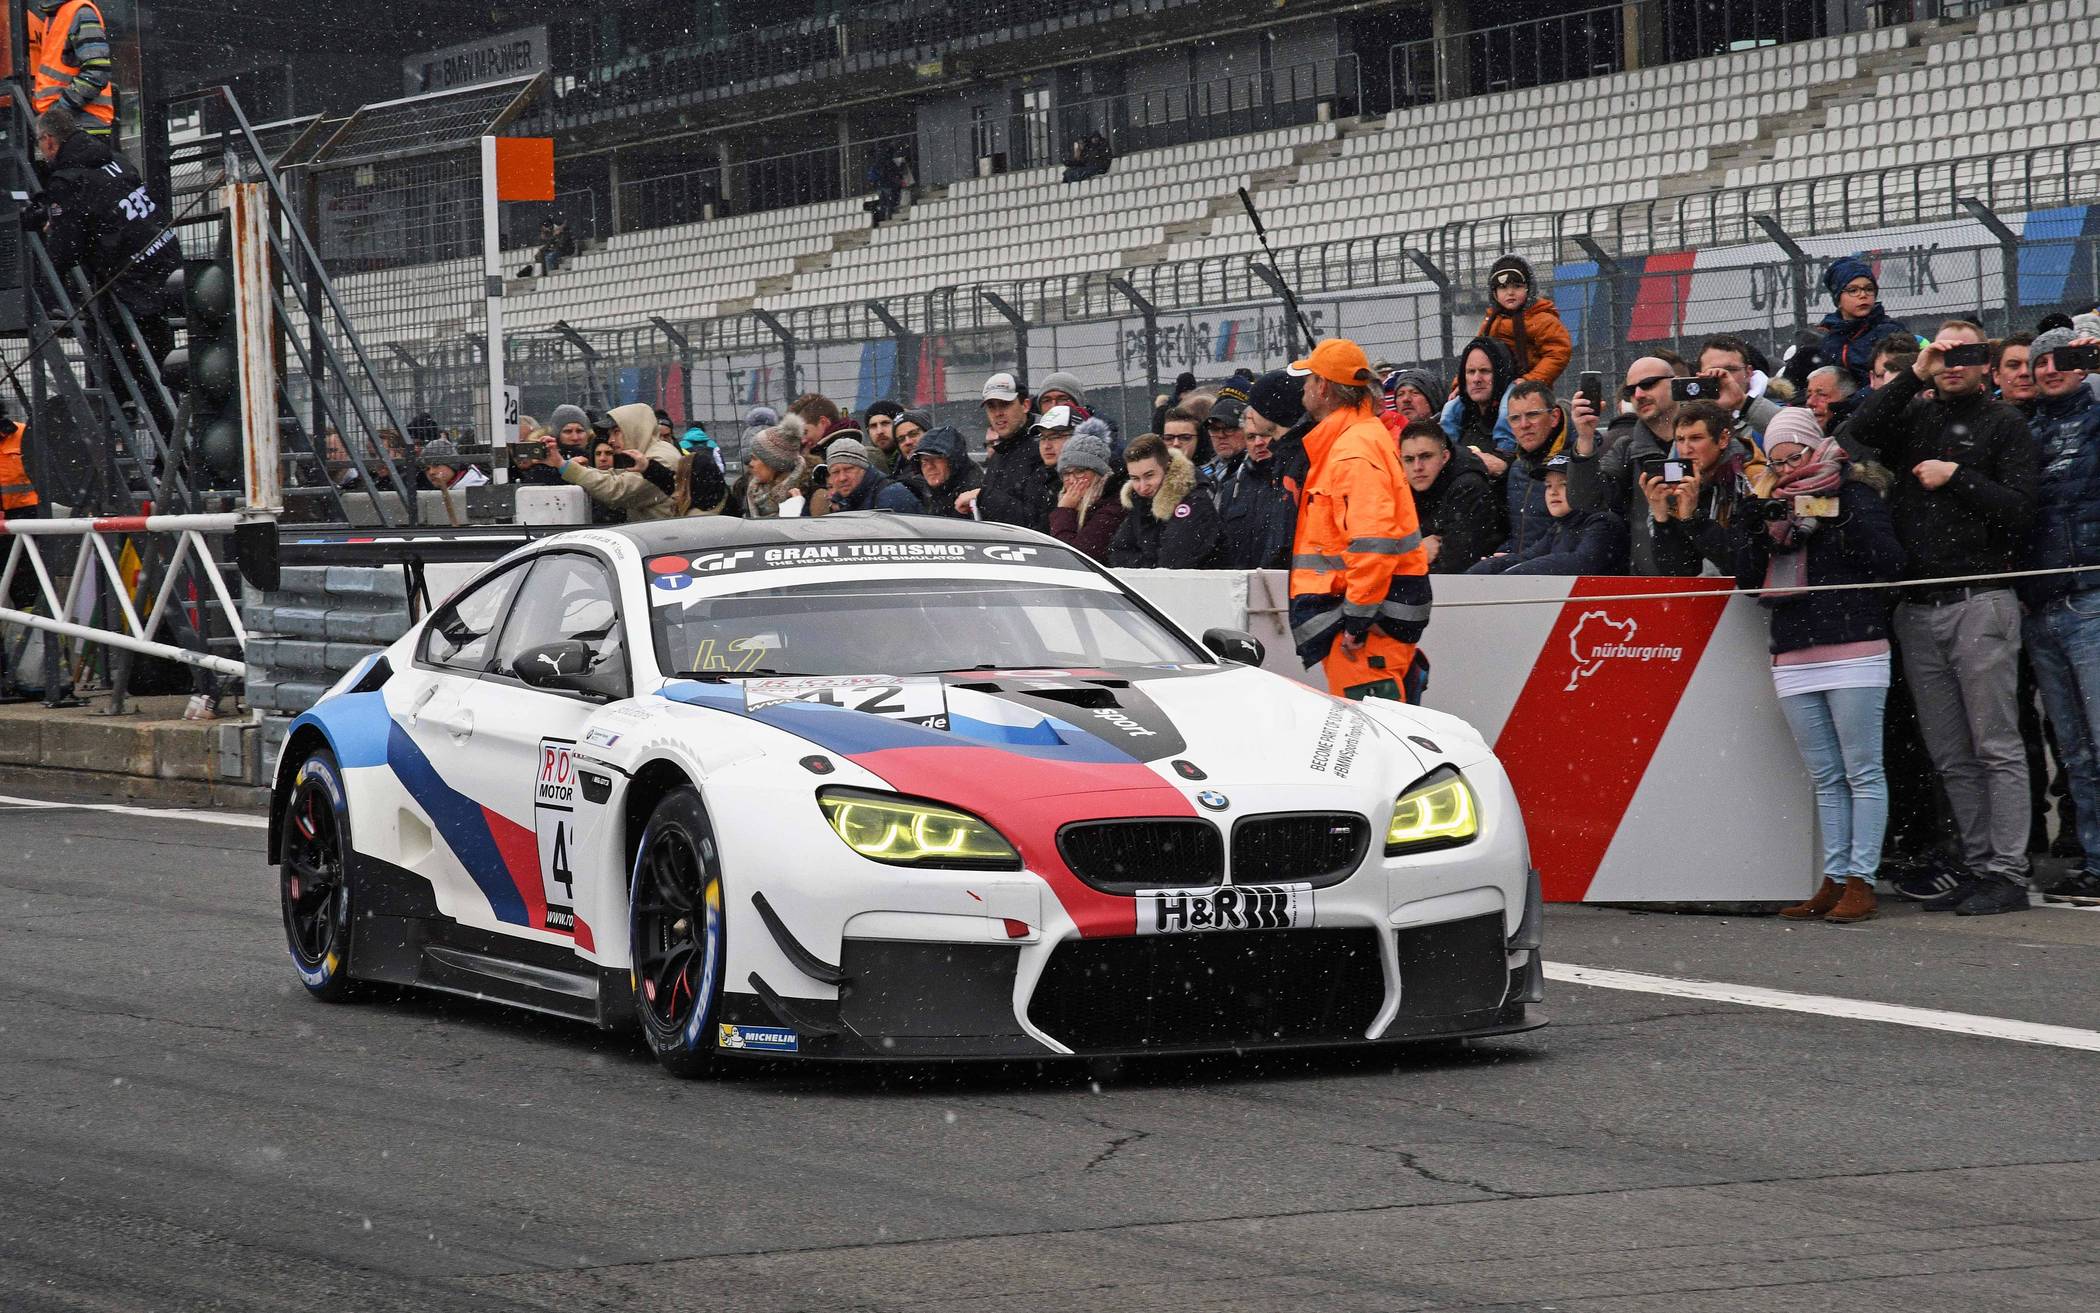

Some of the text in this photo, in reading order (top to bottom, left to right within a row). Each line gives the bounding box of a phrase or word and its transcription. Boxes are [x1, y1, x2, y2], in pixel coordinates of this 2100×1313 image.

[488, 40, 532, 77] POWER
[101, 160, 123, 177] TV
[118, 185, 156, 221] 235
[764, 545, 835, 562] GRAN
[799, 557, 831, 565] REAL
[833, 555, 888, 564] DRIVING
[661, 574, 683, 589] T
[1591, 643, 1682, 661] nürburgring
[794, 685, 905, 714] 42
[1093, 707, 1157, 737] sport
[542, 748, 576, 785] RO
[1311, 740, 1334, 772] BECOME
[539, 783, 573, 801] MOTOR
[552, 820, 573, 900] 4
[1155, 888, 1245, 931] H&R
[745, 1032, 796, 1043] MICHELIN
